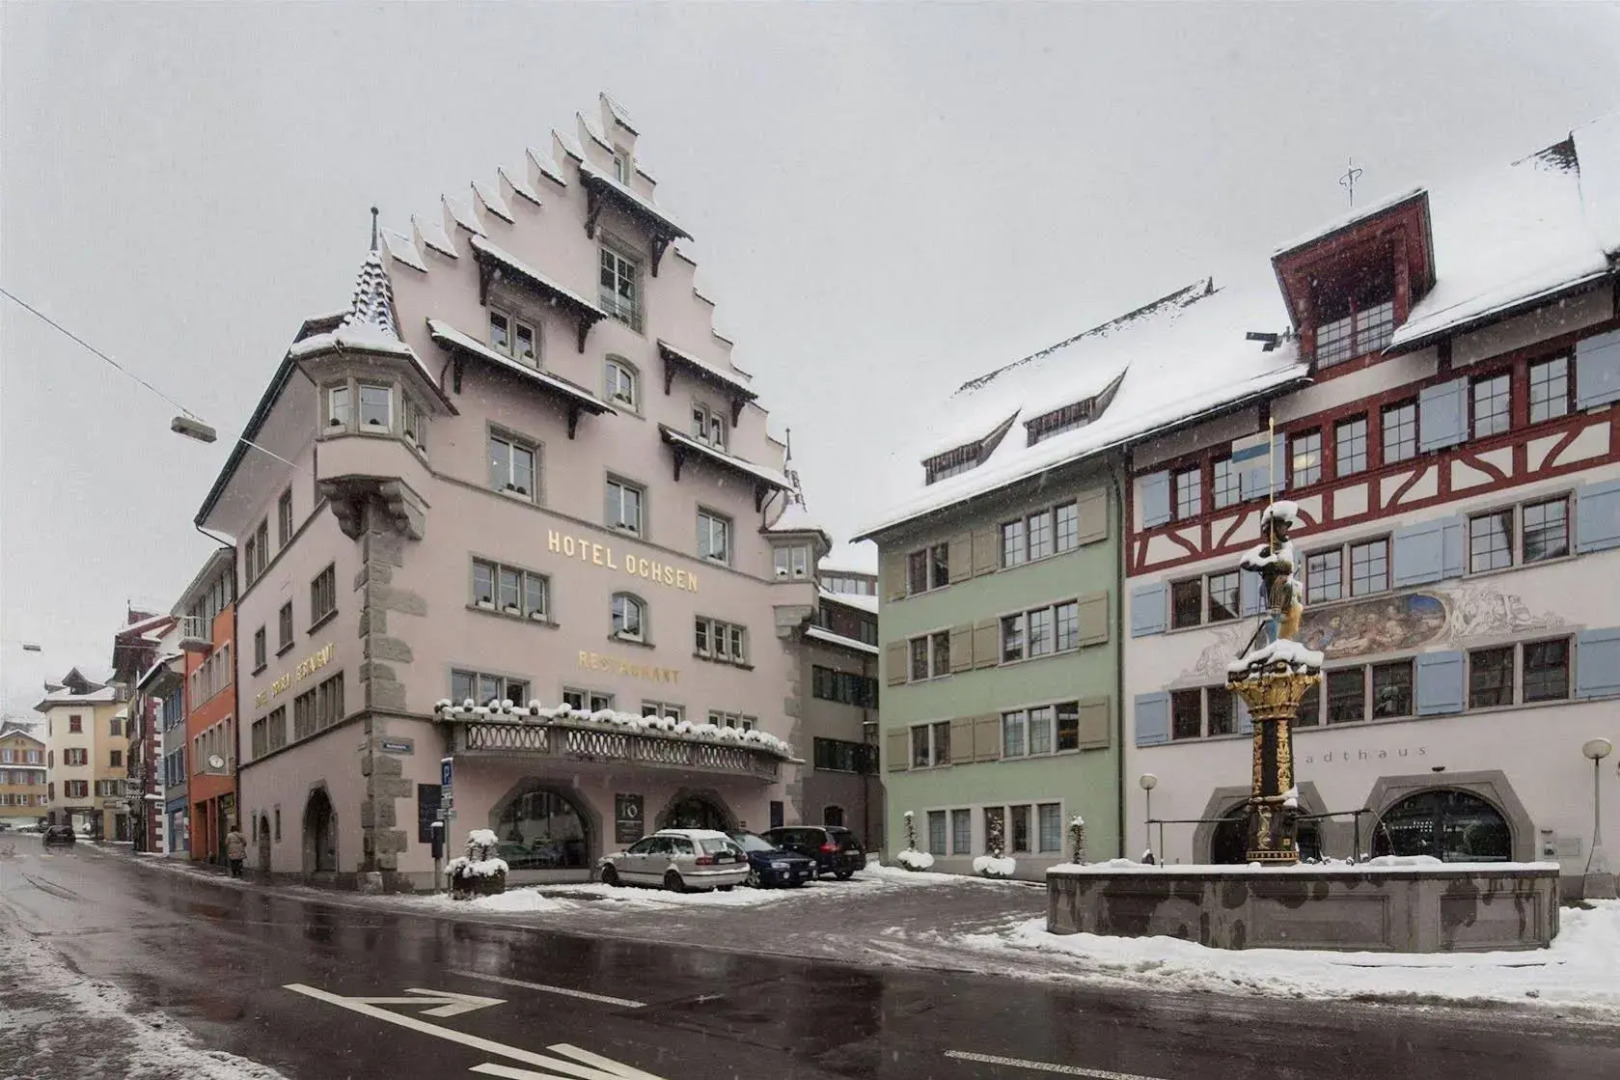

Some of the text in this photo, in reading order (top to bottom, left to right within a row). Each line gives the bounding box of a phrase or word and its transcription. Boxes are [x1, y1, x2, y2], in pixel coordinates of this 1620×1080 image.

[548, 529, 699, 593] HOTEL OCHSEN
[1304, 746, 1427, 764] adthaus
